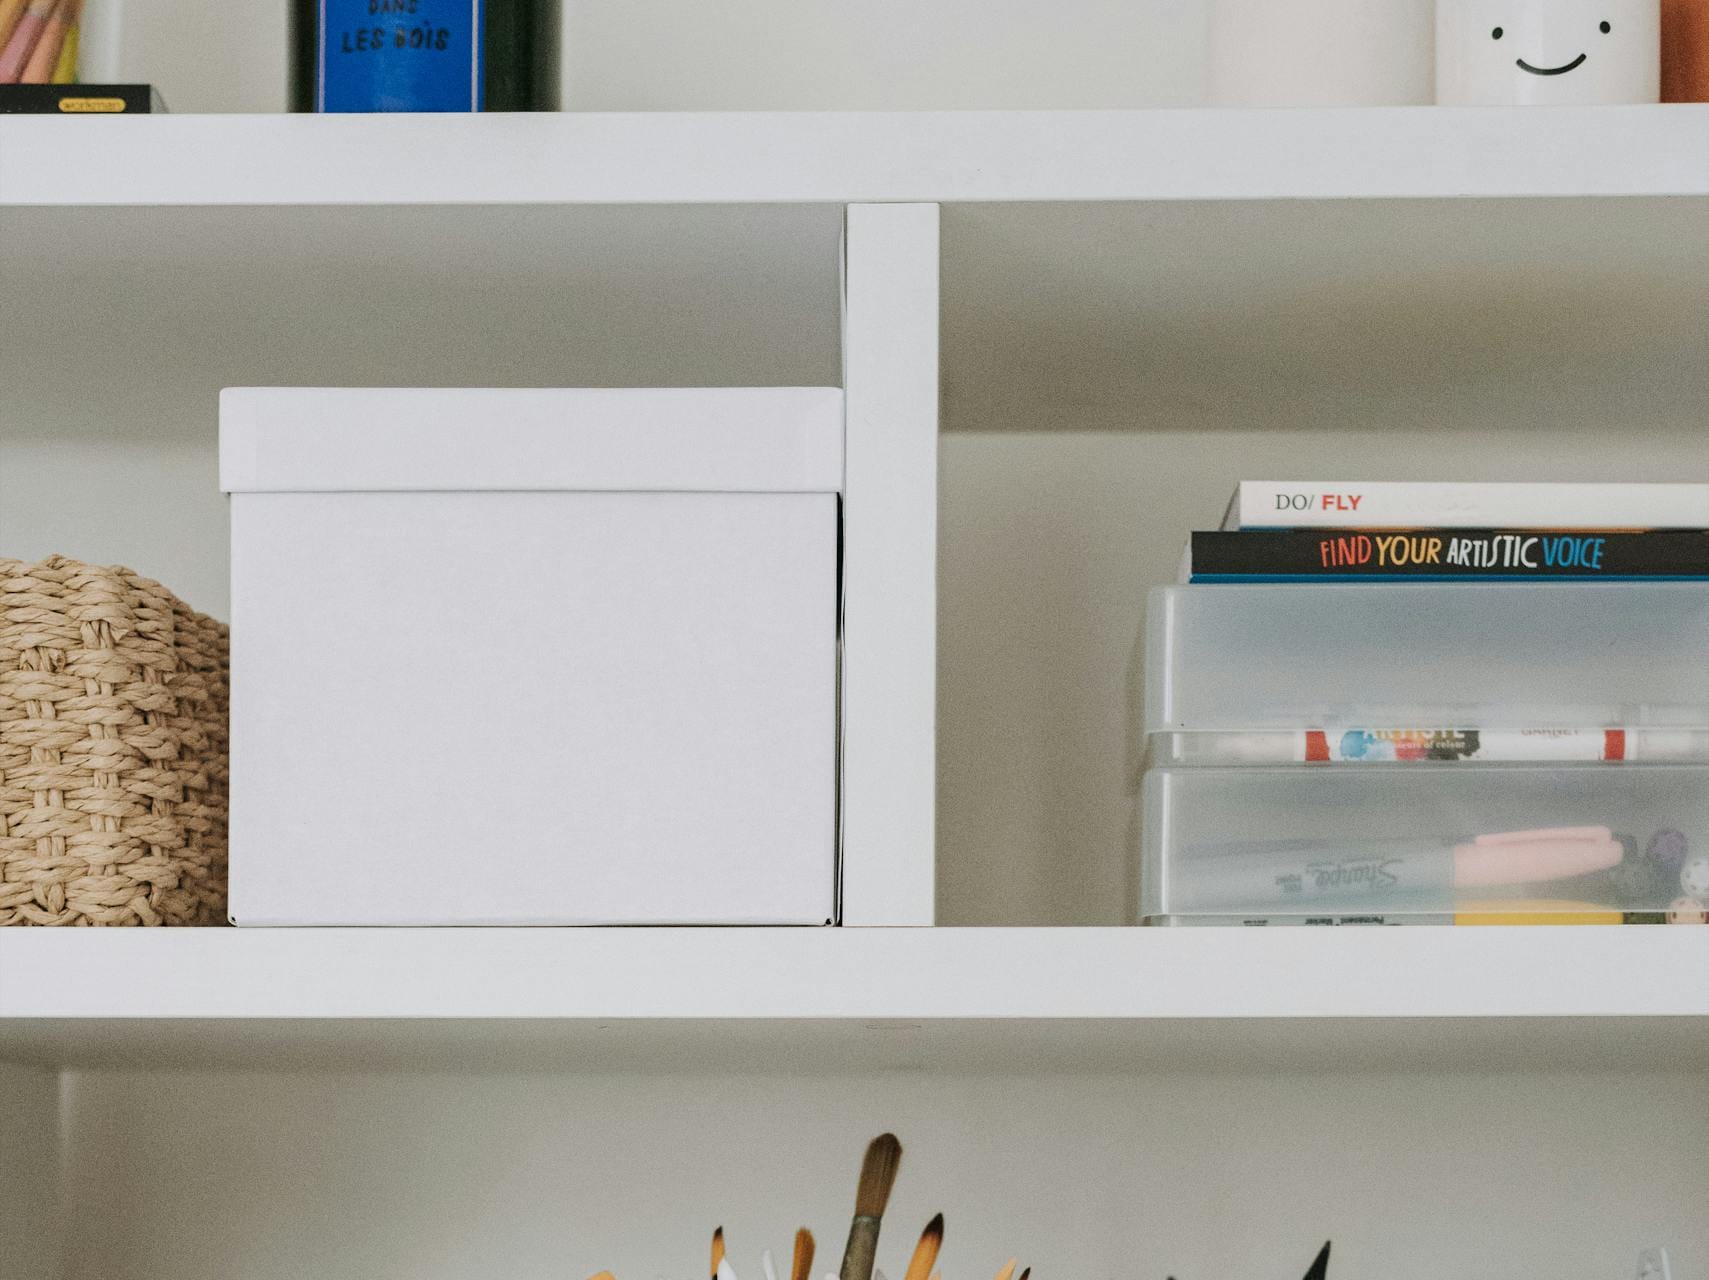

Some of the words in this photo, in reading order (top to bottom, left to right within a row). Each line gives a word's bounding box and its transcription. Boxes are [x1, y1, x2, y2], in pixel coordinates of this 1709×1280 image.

[341, 27, 383, 53] LES
[1275, 494, 1314, 510] DO/
[1321, 495, 1362, 510] FLY
[1320, 535, 1372, 567] FIND
[1375, 535, 1442, 566] YOUR
[1446, 535, 1538, 568] ARTISTIC
[1542, 536, 1605, 569] VOICE
